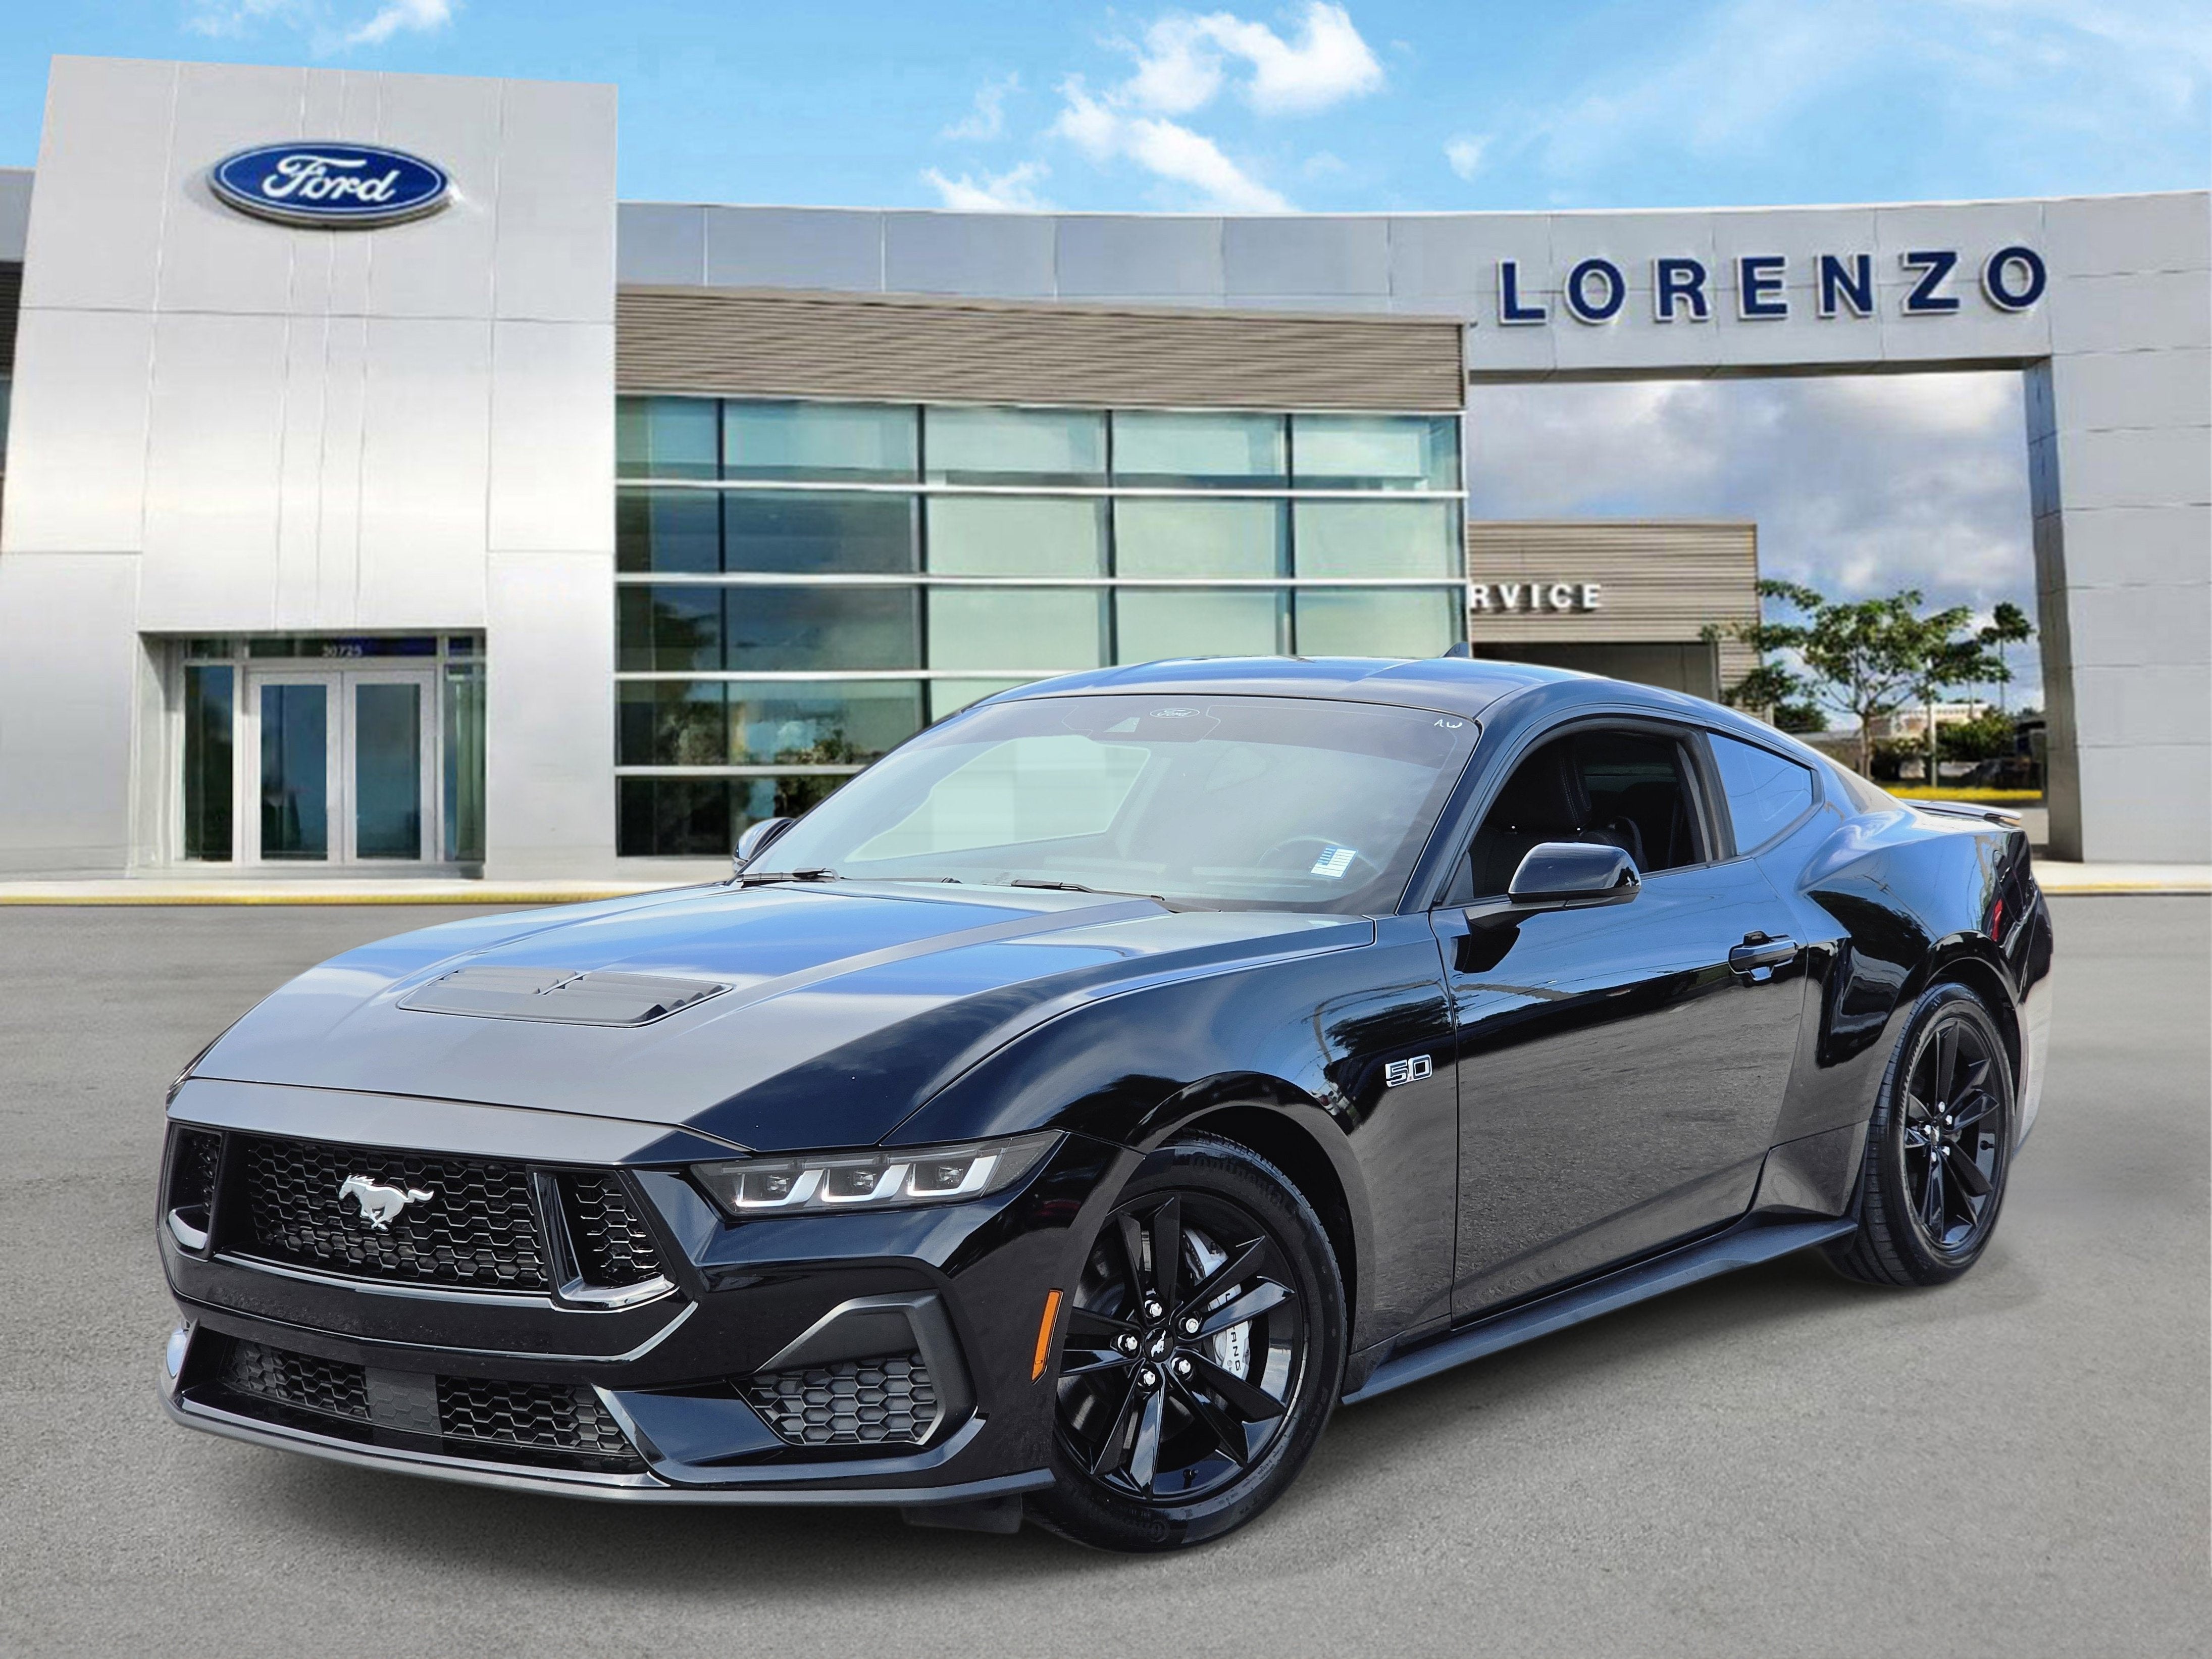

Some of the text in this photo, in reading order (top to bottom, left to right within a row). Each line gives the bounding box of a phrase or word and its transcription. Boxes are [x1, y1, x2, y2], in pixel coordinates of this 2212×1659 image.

[262, 155, 400, 202] Ford
[1497, 246, 2046, 324] LORENZO
[1157, 709, 1192, 717] Ford
